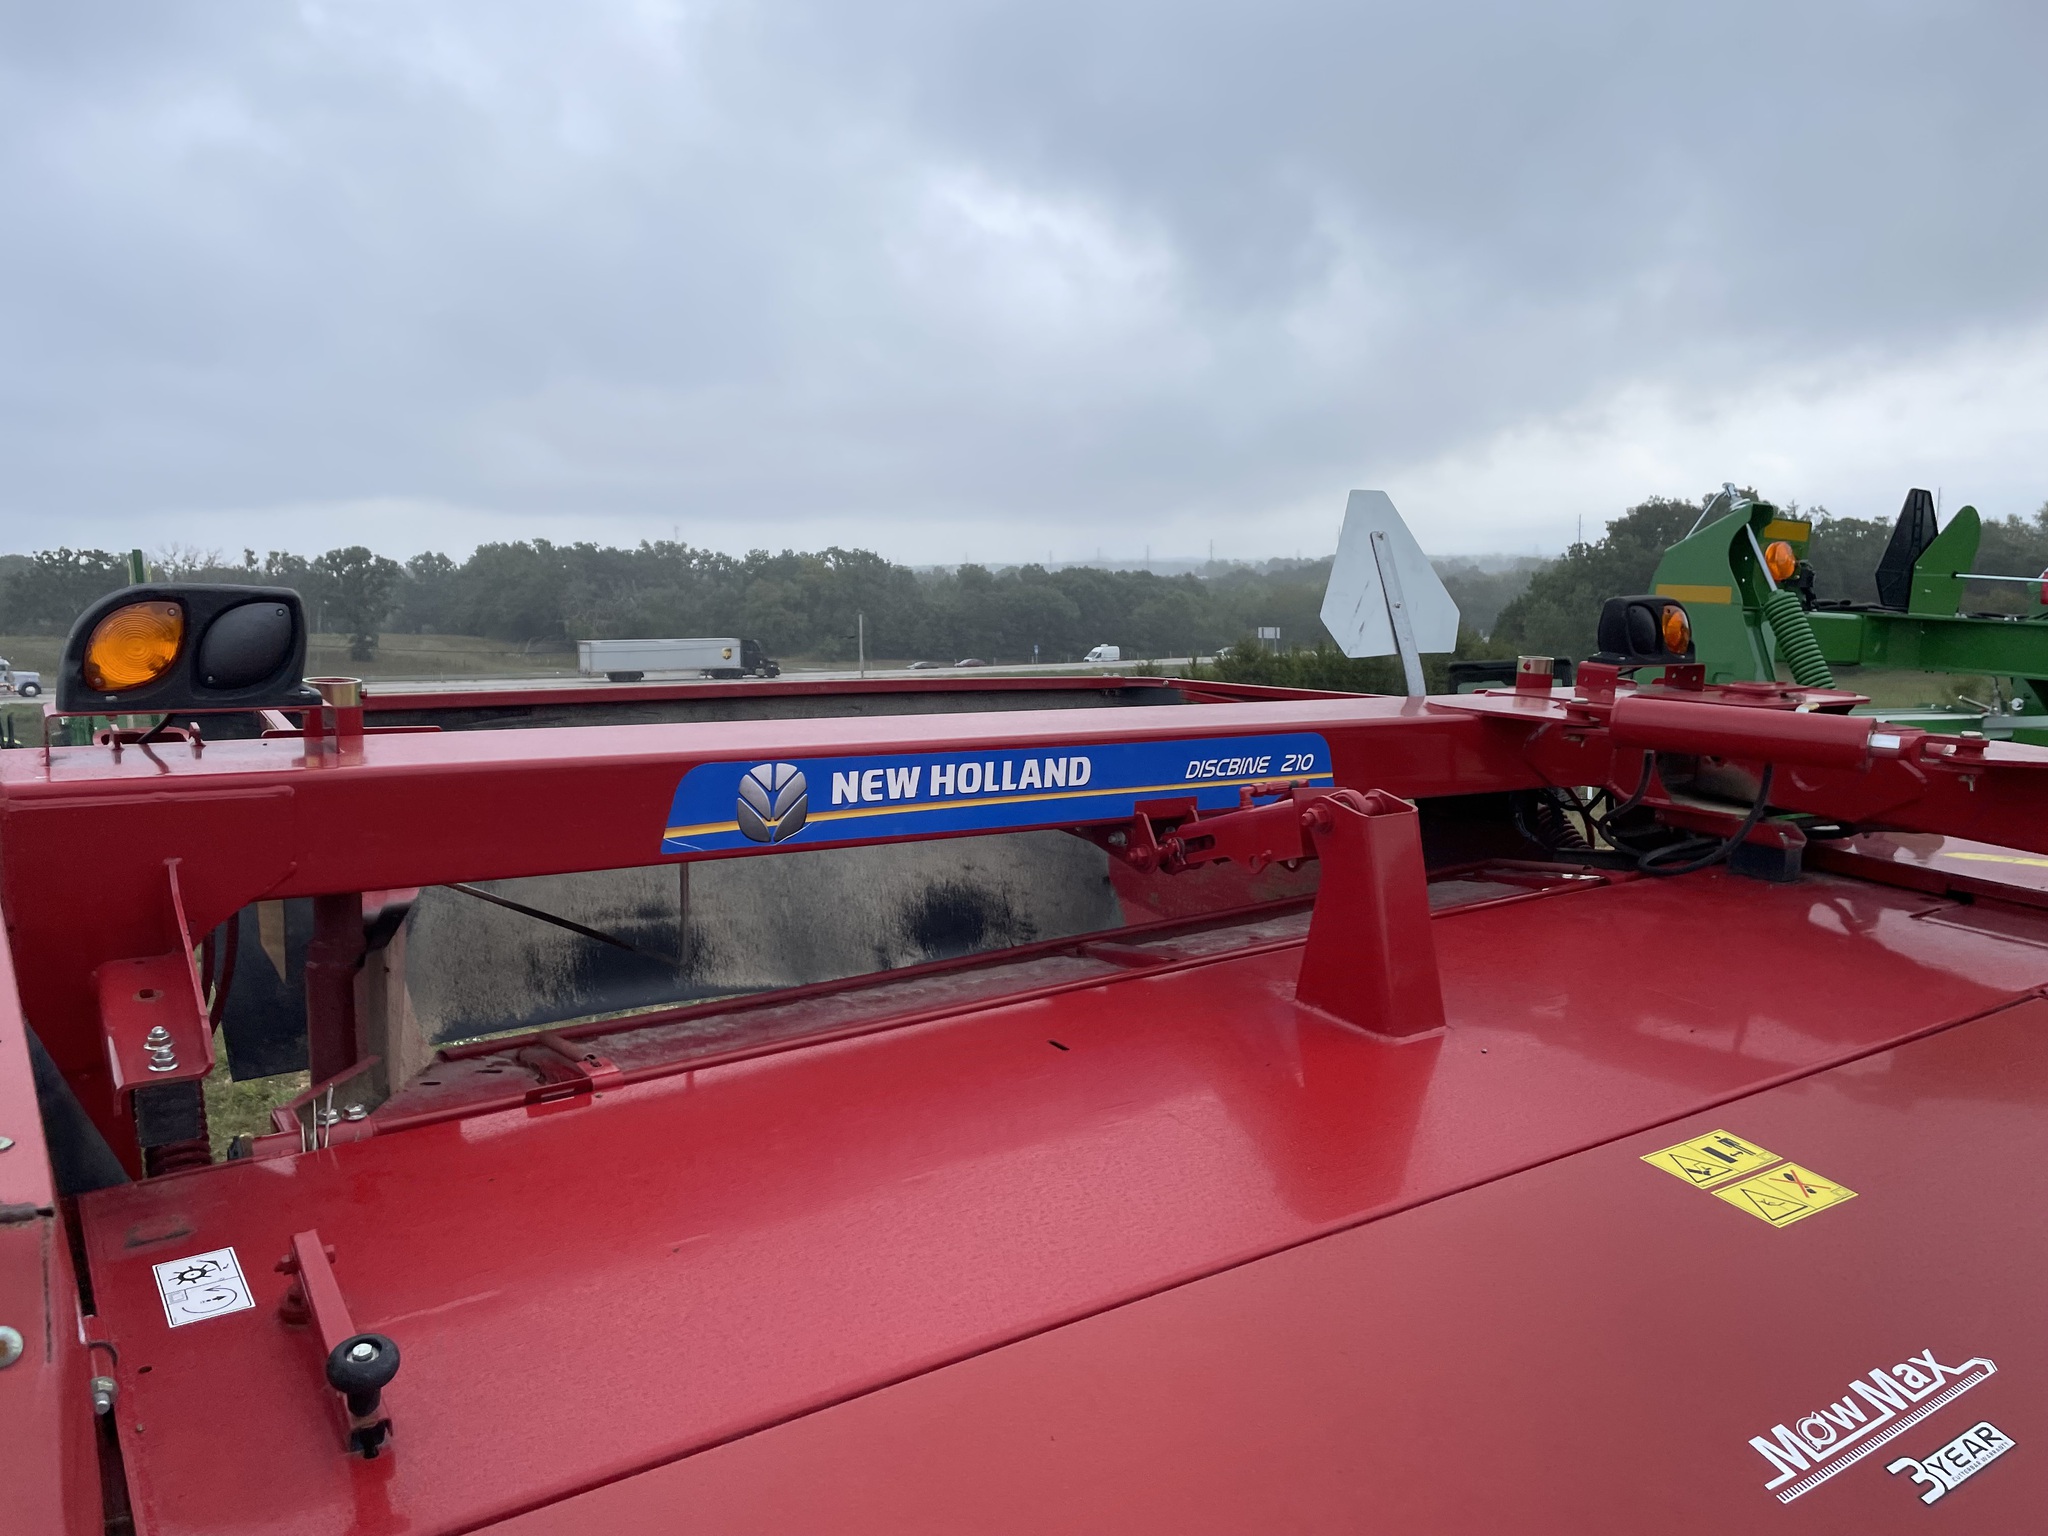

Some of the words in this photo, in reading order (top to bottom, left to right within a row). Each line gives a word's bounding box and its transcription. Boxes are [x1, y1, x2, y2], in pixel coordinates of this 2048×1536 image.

[831, 766, 921, 805] NEW
[930, 756, 1092, 796] HOLLAND
[1185, 755, 1271, 779] DISCBINE
[1280, 753, 1314, 772] 210
